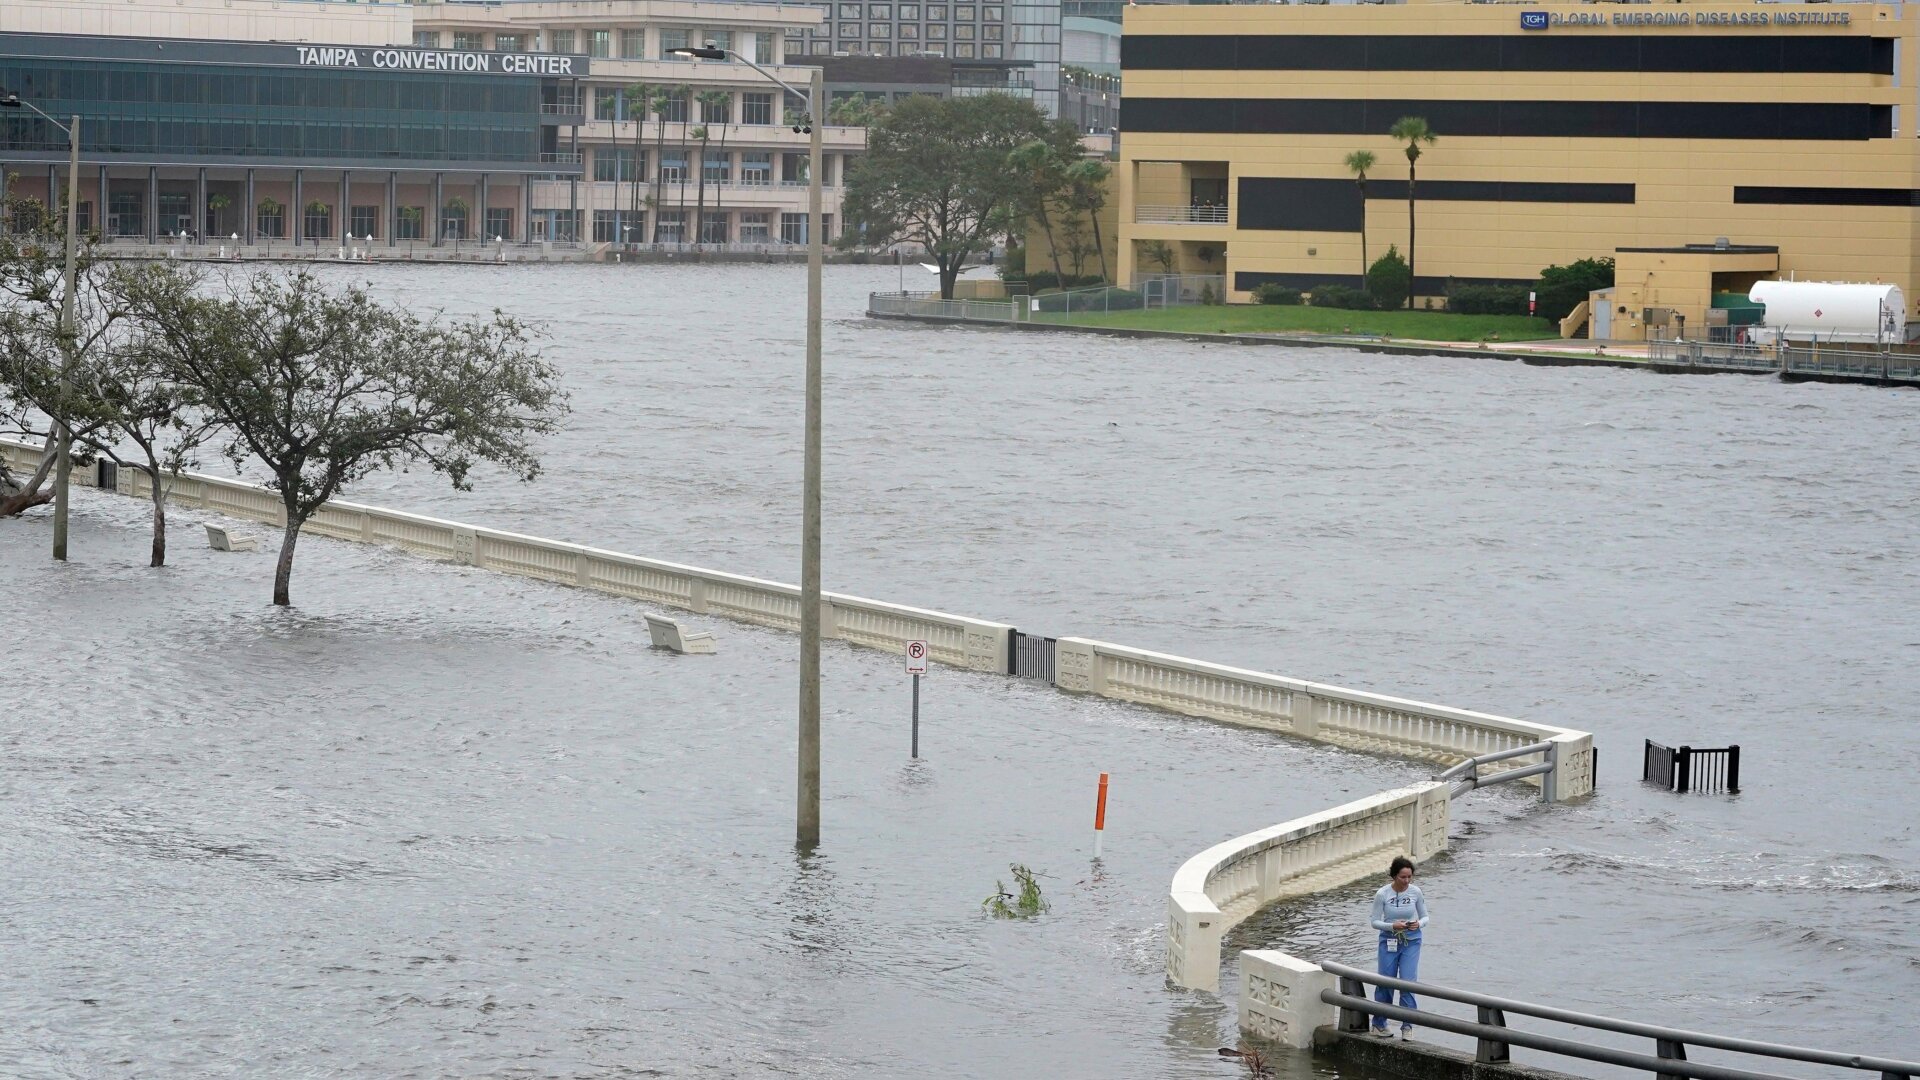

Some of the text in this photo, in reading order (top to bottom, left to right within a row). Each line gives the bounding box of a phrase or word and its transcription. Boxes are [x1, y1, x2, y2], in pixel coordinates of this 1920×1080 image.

[1525, 12, 1850, 25] TGH GLOBAL EMERGING DISEASES INSTITUTE
[297, 47, 572, 74] TAMPA CONVENTION CENTER
